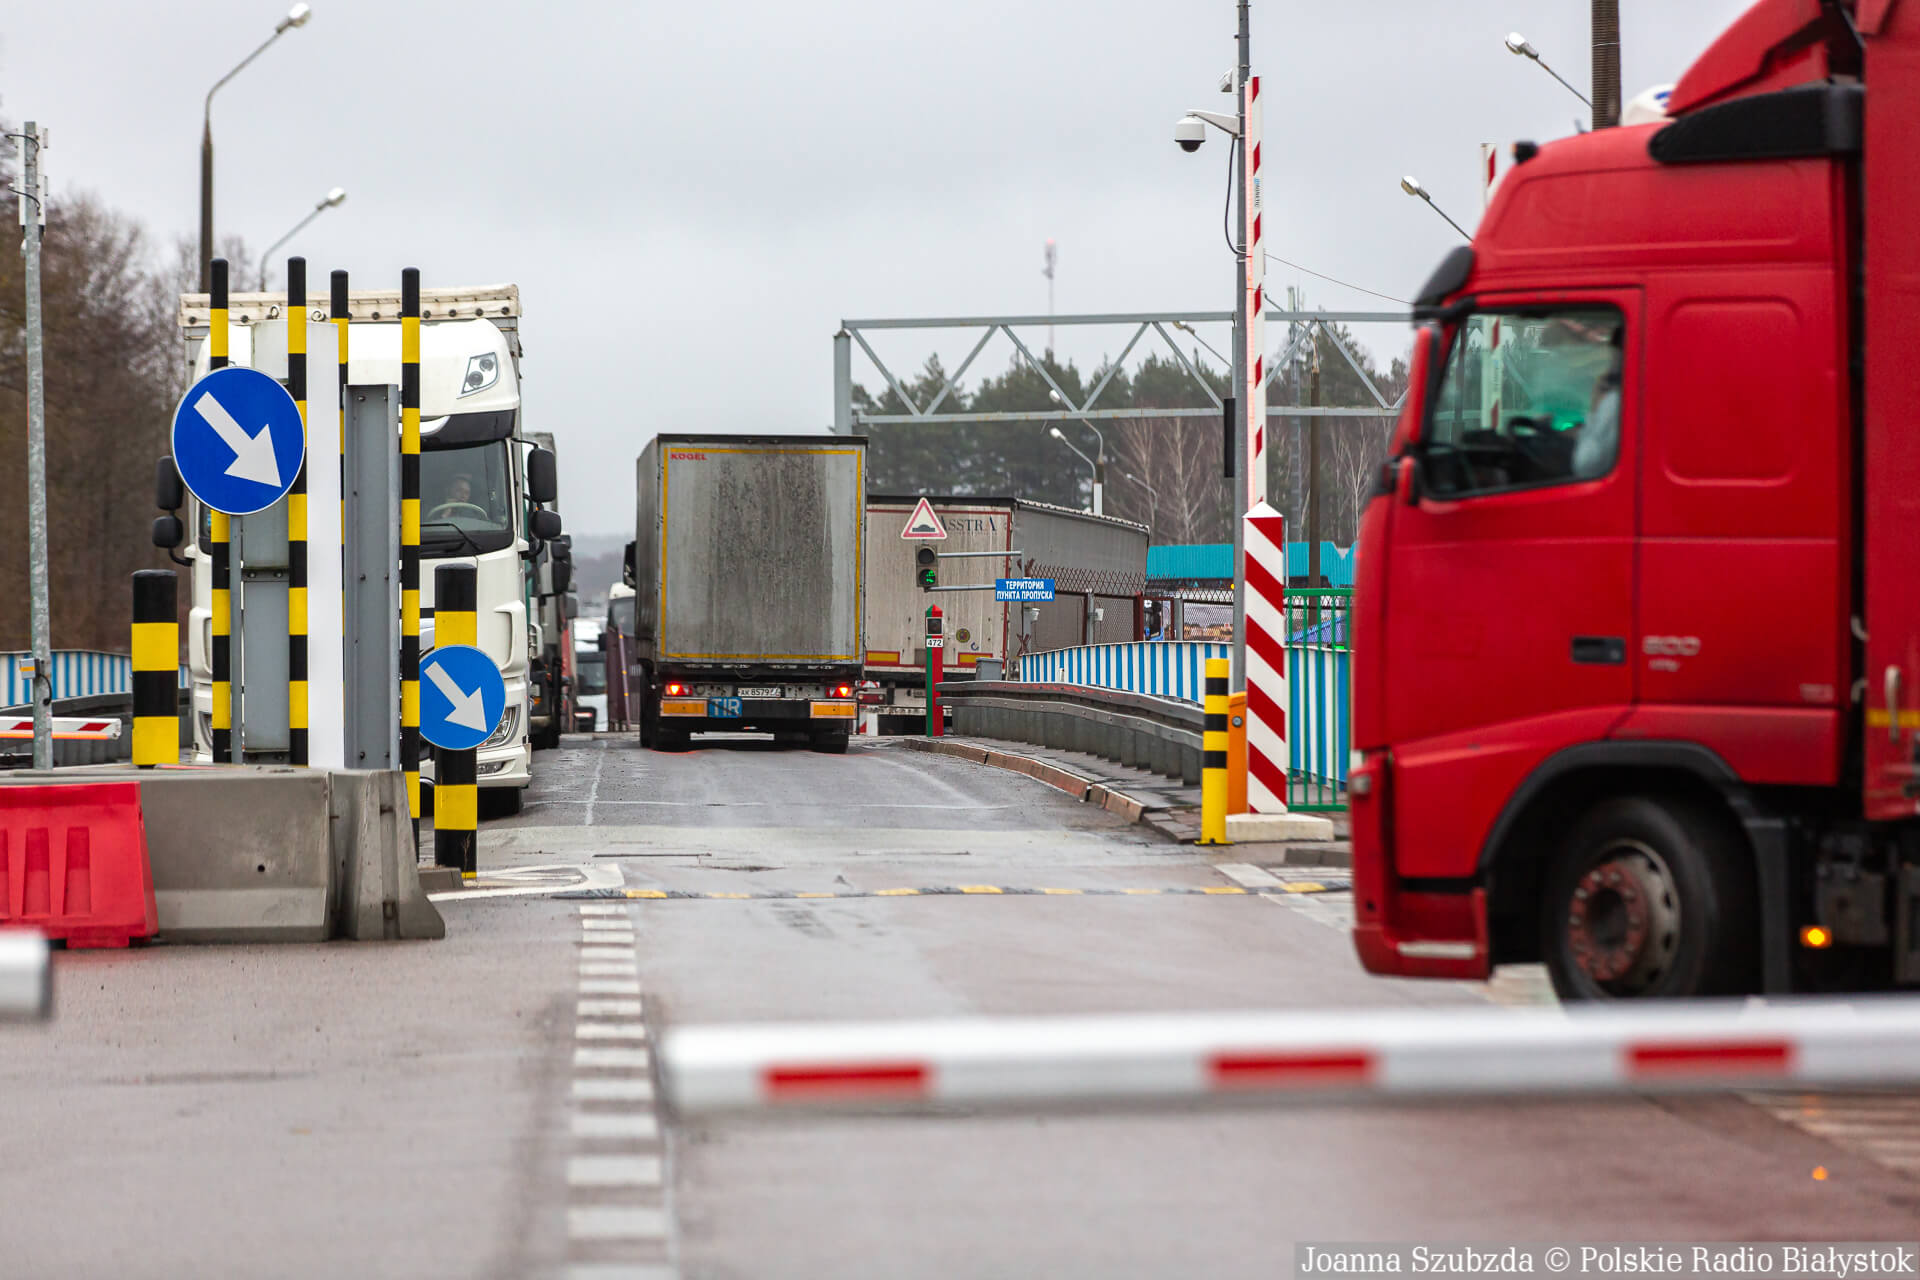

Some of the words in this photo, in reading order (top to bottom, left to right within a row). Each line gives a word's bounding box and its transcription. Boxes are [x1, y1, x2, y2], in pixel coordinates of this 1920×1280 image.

[1005, 580, 1045, 590] ТЕРРИТОРИЯ
[996, 590, 1021, 600] ПУНКТА
[1021, 590, 1053, 600] ПРОПУСКА
[927, 639, 942, 647] 472
[711, 698, 741, 716] TIR
